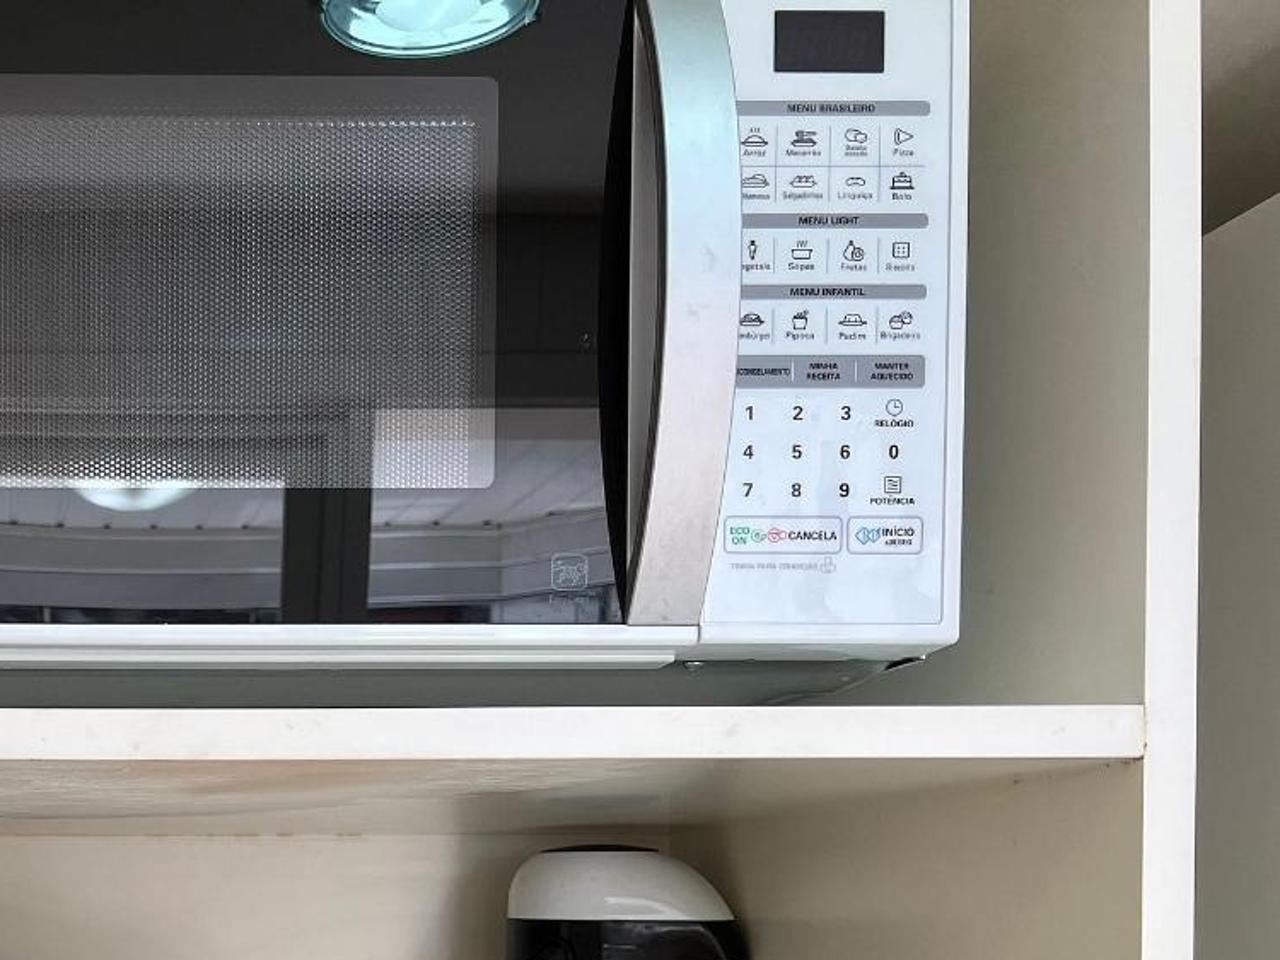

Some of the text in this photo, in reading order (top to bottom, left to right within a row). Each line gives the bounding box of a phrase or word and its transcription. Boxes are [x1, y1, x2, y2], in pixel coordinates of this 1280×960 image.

[787, 103, 876, 113] MENU BRASILEIRO
[892, 192, 912, 201] Bolo
[798, 216, 860, 226] MENU LIGHT
[788, 262, 815, 272] Sopas
[790, 287, 865, 297] MENU INFANTIL
[809, 362, 839, 370] MINHA
[874, 362, 909, 370] MANTER
[806, 372, 841, 381] RECEITA
[870, 372, 914, 381] AQUECIDO
[745, 405, 754, 421] 1
[792, 405, 804, 421] 2
[840, 405, 851, 421] 3
[743, 444, 754, 460] 4
[791, 444, 803, 460] 5
[839, 444, 851, 460] 6
[888, 444, 899, 460] 0
[742, 482, 754, 498] 7
[791, 482, 802, 498] 8
[838, 482, 850, 498] 9
[729, 526, 750, 535] ECO
[788, 530, 837, 541] CANCELA
[881, 525, 915, 537] INÍCIO
[731, 536, 747, 545] ON
